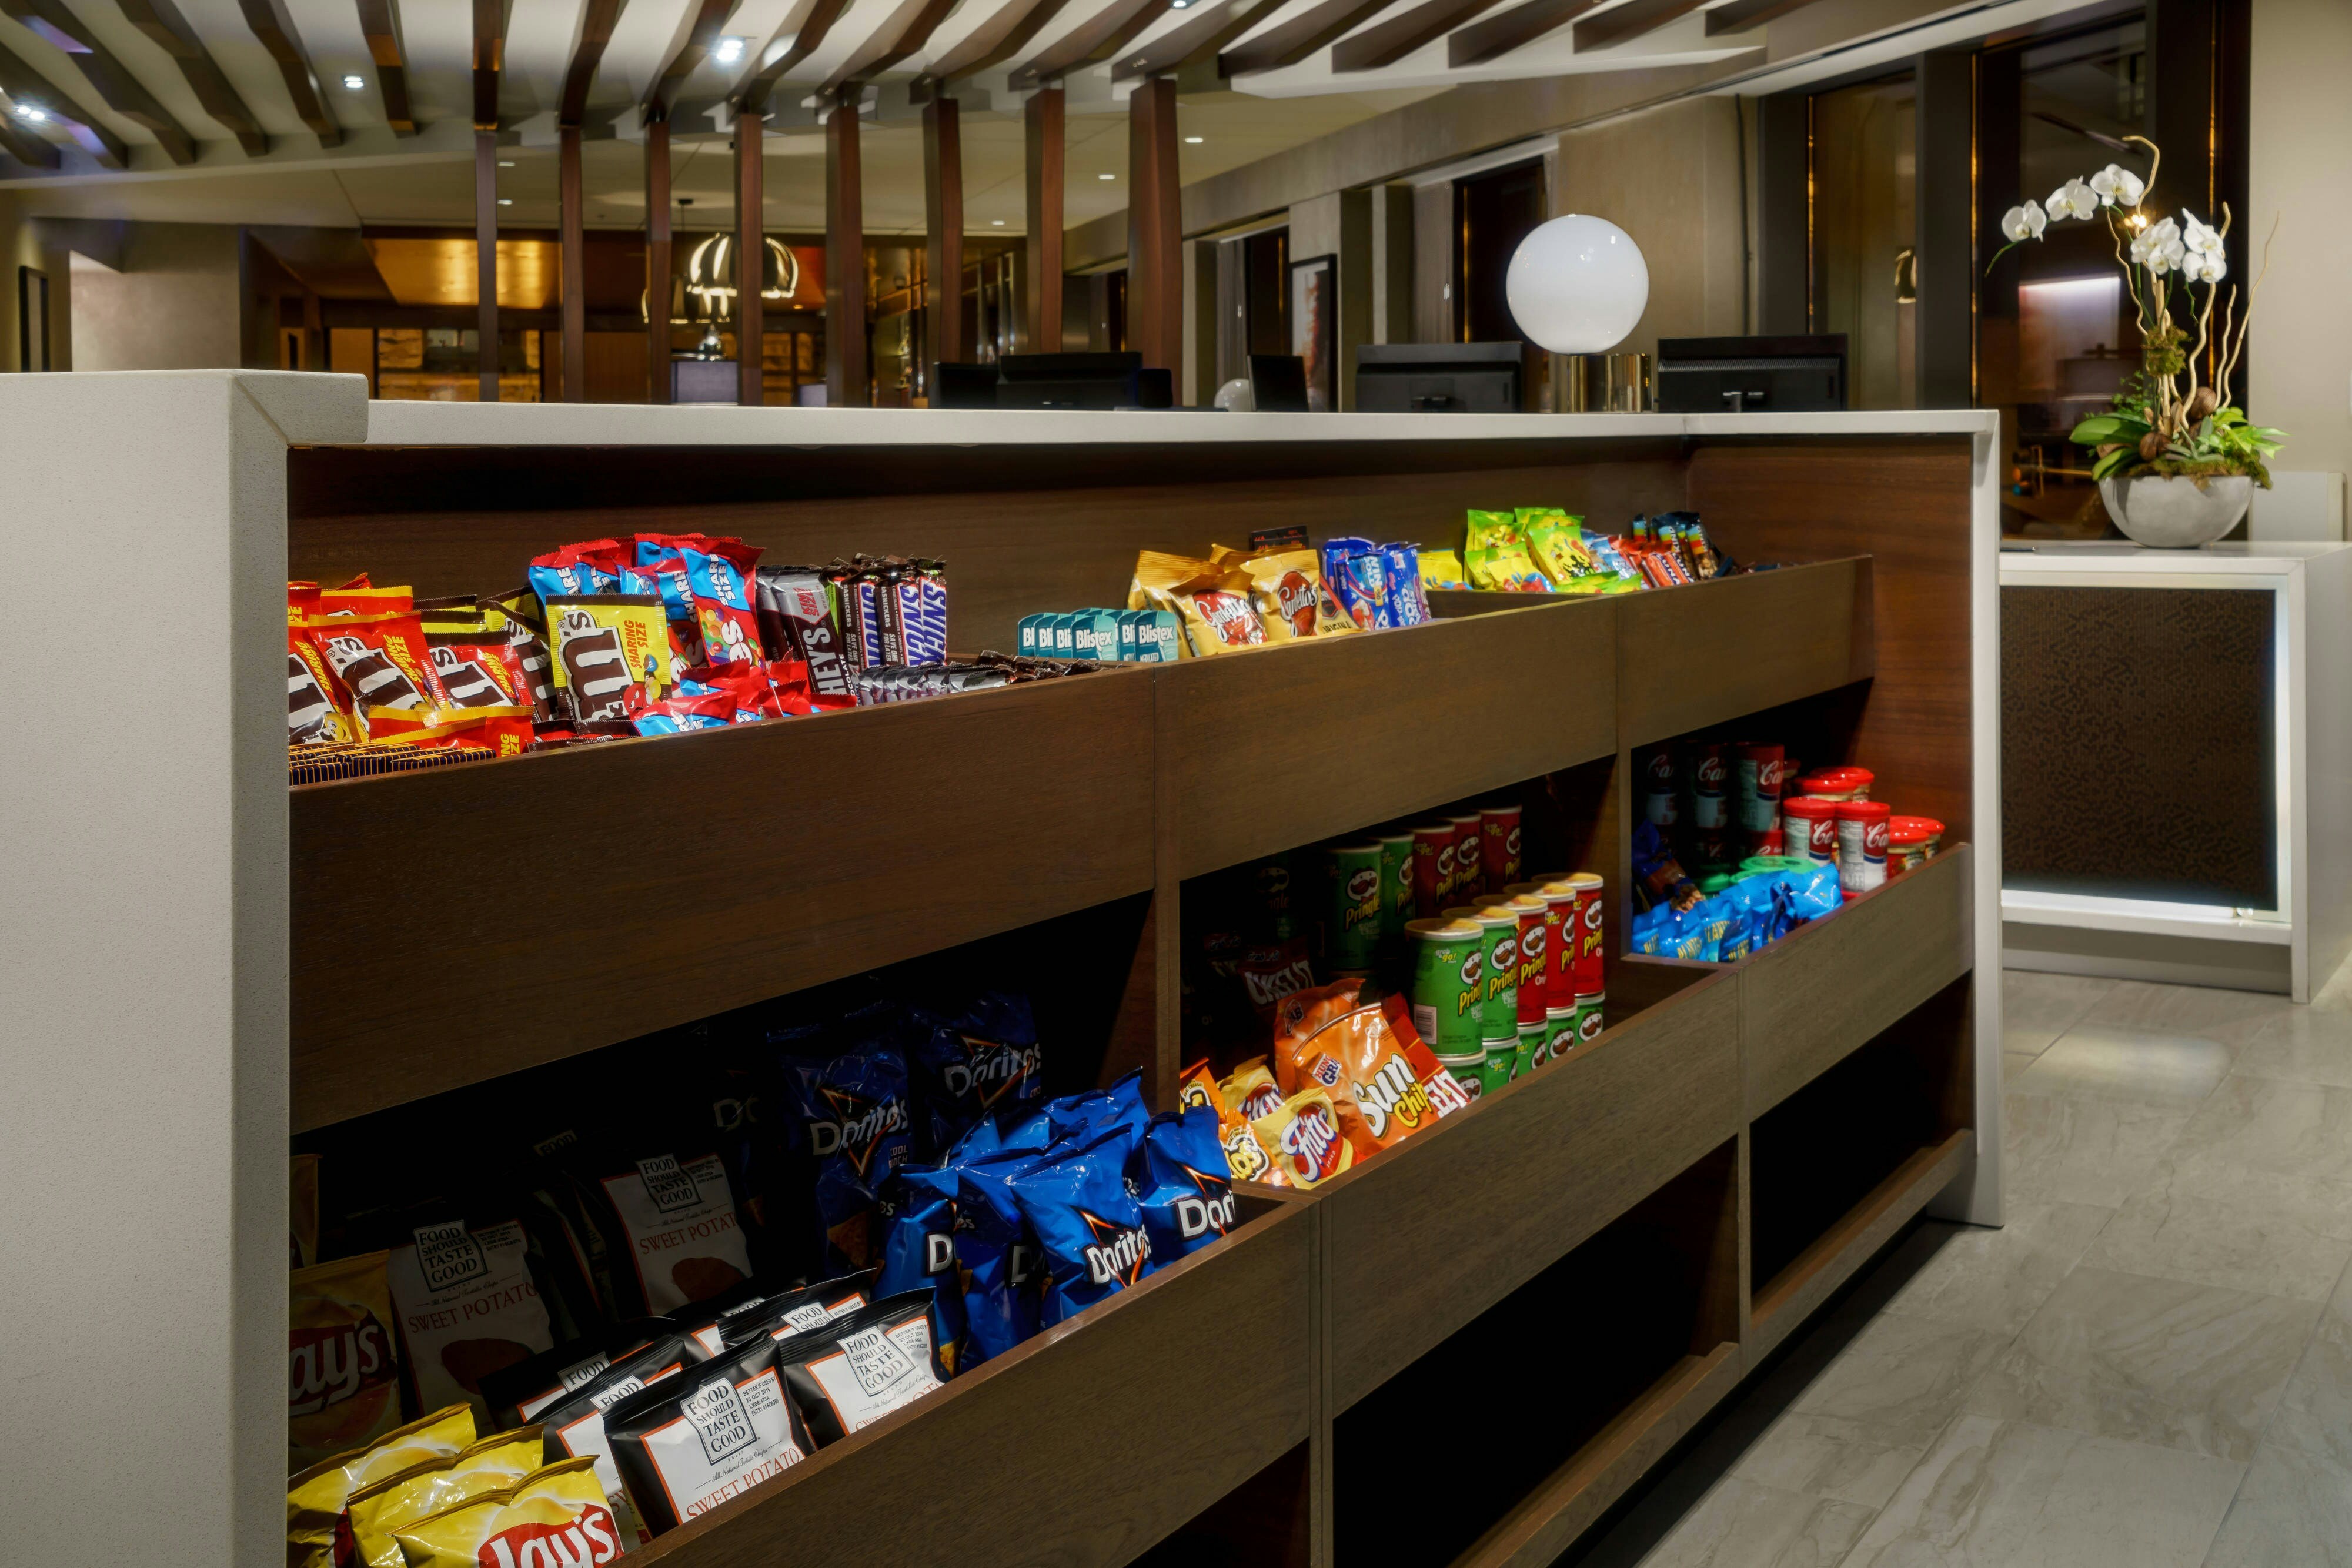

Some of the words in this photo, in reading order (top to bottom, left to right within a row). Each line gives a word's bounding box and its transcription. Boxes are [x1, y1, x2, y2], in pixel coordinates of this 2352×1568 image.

[709, 554, 729, 606] SHARE
[718, 564, 736, 601] SIZE
[623, 619, 642, 669] SHARING
[635, 621, 649, 648] SIZE
[1075, 629, 1113, 652] Blistex
[1138, 624, 1174, 647] Blistex
[383, 634, 422, 683] SHARING
[392, 636, 416, 664] SIZE
[1140, 652, 1160, 663] MEDICATED
[295, 640, 333, 693] SHARING
[1435, 948, 1451, 957] grab
[1442, 952, 1457, 963] go!
[1353, 1054, 1416, 1138] Sun
[809, 1098, 909, 1156] Doritos
[642, 1159, 675, 1174] FOOD
[647, 1171, 681, 1184] SHOULD
[652, 1176, 689, 1194] TASTE
[660, 1187, 693, 1205] GOOD
[418, 1227, 462, 1246] FOOD
[422, 1237, 467, 1256] SHOULD
[639, 1229, 687, 1255] SWEET
[425, 1244, 474, 1269] TASTE
[431, 1258, 477, 1283] GOOD
[409, 1308, 459, 1334] SWEET
[791, 1306, 823, 1325] FOOD
[800, 1316, 831, 1333] SHOULD
[834, 1307, 846, 1317] BETTER
[846, 1333, 879, 1353] FOOD
[894, 1330, 910, 1338] BETTER
[852, 1344, 887, 1364] SHOULD
[857, 1350, 896, 1377] TASTE
[566, 1360, 606, 1386] FOOD
[864, 1360, 903, 1389] GOOD
[600, 1381, 640, 1406] FOOD
[686, 1385, 729, 1416] FOOD
[742, 1386, 759, 1397] BETTER
[761, 1379, 772, 1388] USED
[751, 1392, 761, 1401] OCT
[761, 1387, 771, 1396] 2016
[880, 1393, 897, 1406] Natural
[896, 1381, 915, 1398] Tortilla
[696, 1399, 734, 1425] SHOULD
[751, 1406, 763, 1416] ENTRY
[703, 1410, 741, 1438] TASTE
[710, 1425, 747, 1453] GOOD
[711, 1471, 722, 1483] All
[721, 1462, 740, 1477] Natural
[739, 1455, 754, 1467] Tortilla
[754, 1448, 769, 1460] Chips
